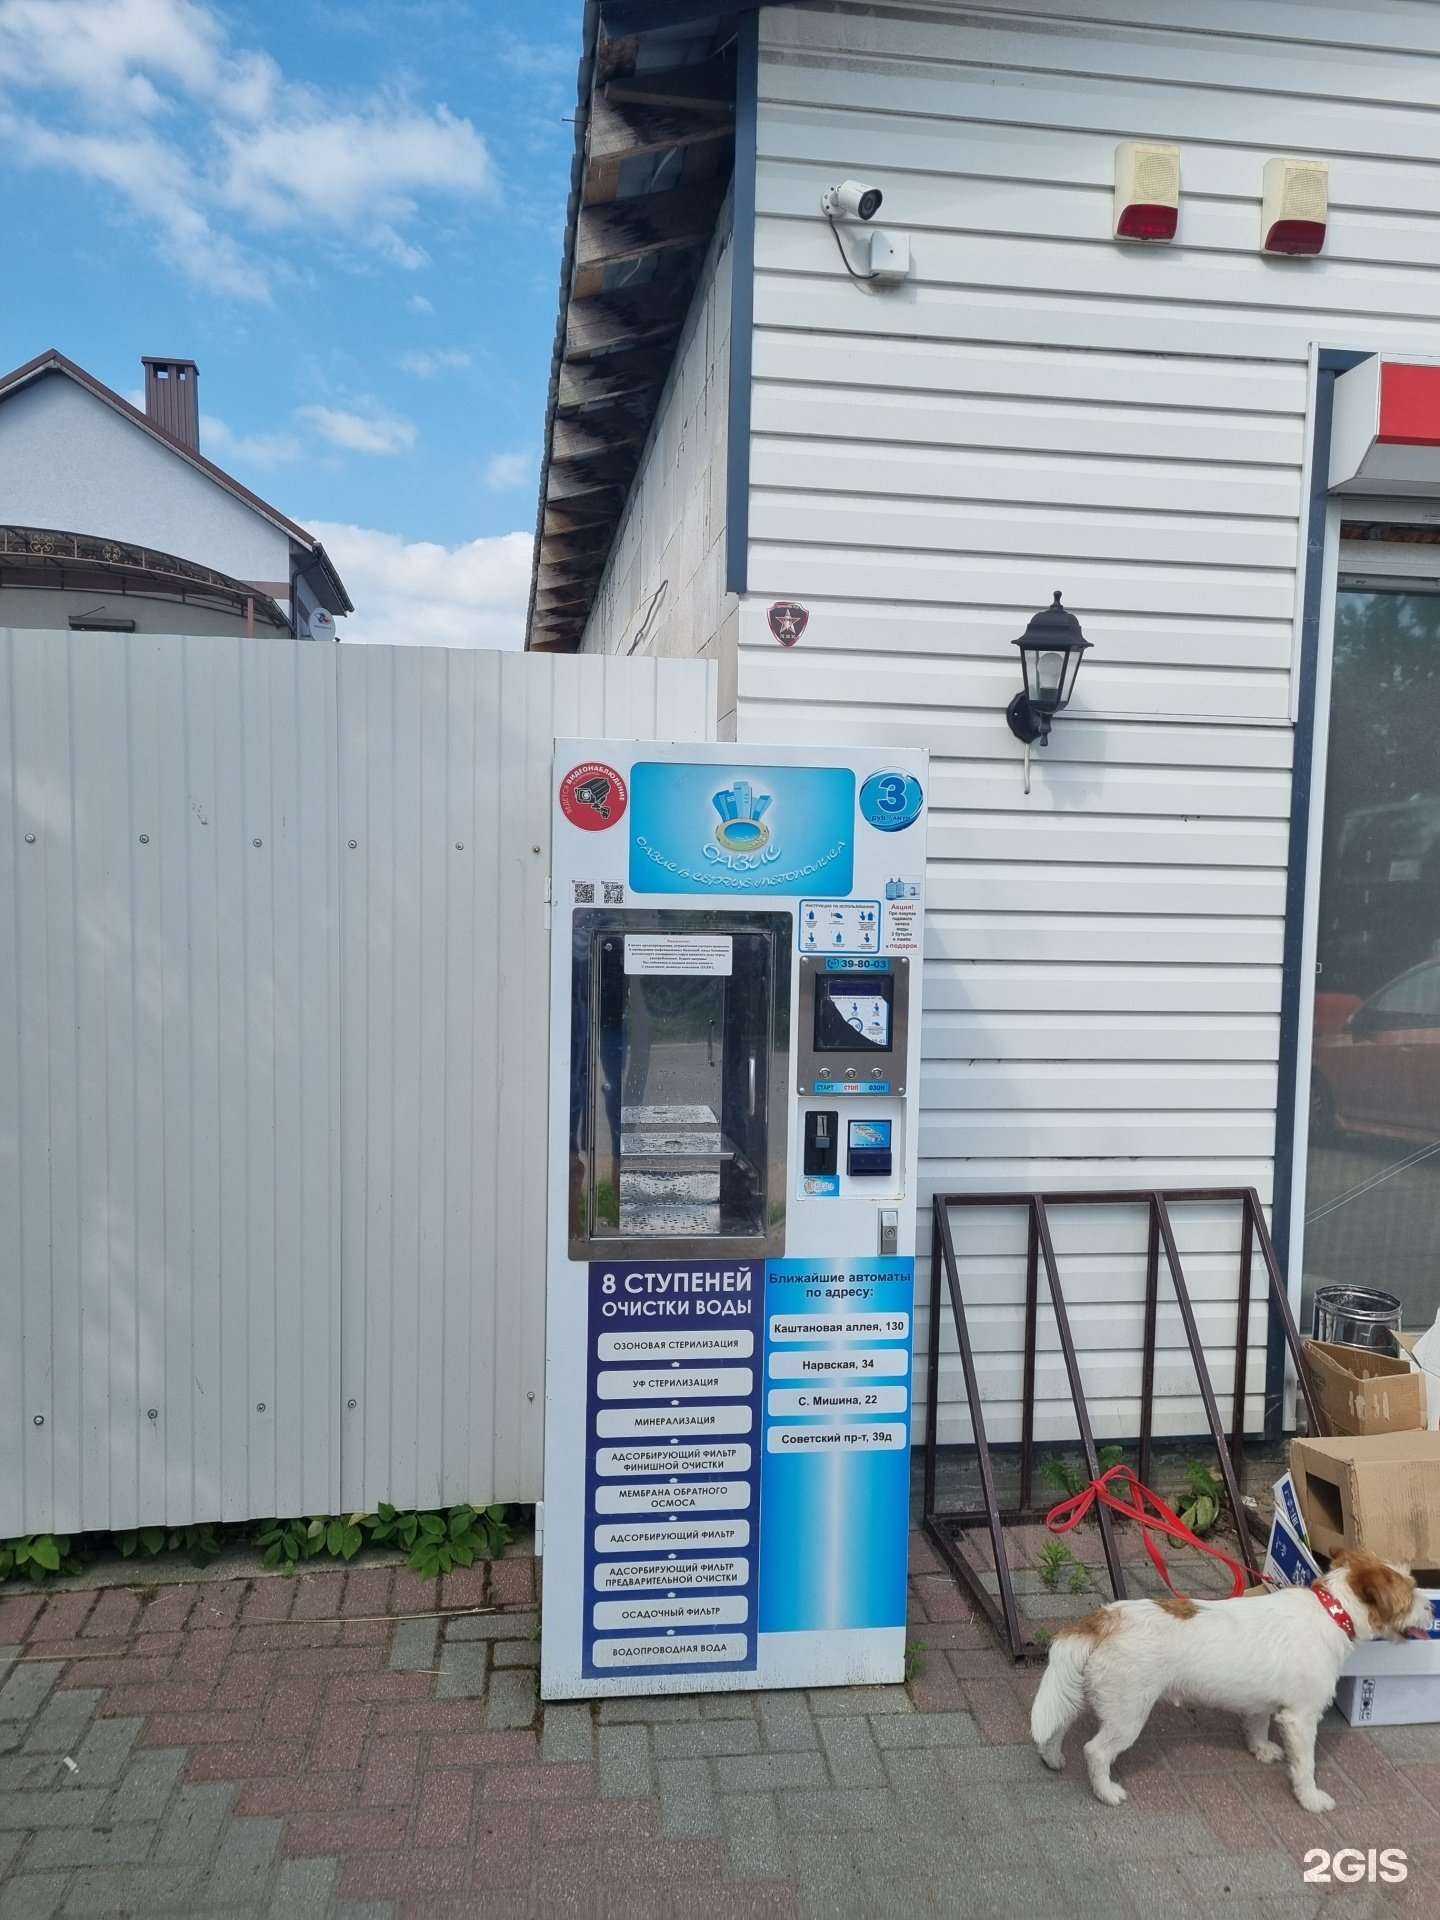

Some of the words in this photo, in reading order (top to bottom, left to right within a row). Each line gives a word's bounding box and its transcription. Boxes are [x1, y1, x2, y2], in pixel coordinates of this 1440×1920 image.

[566, 765, 625, 801] ВИДЕОНАБЛЮДЕНИЕ
[878, 775, 907, 814] 3
[702, 842, 782, 871] ОАЗИС
[840, 959, 887, 969] 39-80-03
[816, 1084, 834, 1092] СТАРТ
[843, 1084, 859, 1092] СТОП
[602, 1273, 617, 1294] 8
[624, 1266, 752, 1294] СТУПЕНЕЙ
[769, 1272, 845, 1284] Ближайшие
[848, 1272, 911, 1282] автоматы
[806, 1288, 821, 1297] по
[825, 1287, 874, 1299] адресу:
[602, 1300, 690, 1317] ОЧИСТКИ
[696, 1299, 752, 1316] ВОДЫ
[774, 1323, 843, 1333] Каштановая
[846, 1324, 882, 1332] аллея,
[885, 1321, 904, 1331] 130
[613, 1341, 666, 1351] ОЗОНОВАЯ
[668, 1340, 739, 1350] СТЕРИЛИЗАЦИЯ
[802, 1360, 858, 1372] Нарвская,
[861, 1359, 874, 1369] 34
[632, 1379, 646, 1388] УФ
[648, 1378, 719, 1388] СТЕРИЛИЗАЦИЯ
[798, 1396, 810, 1406] С.
[813, 1395, 862, 1406] Мишина,
[865, 1394, 878, 1404] 22
[634, 1416, 716, 1426] МИНЕРАЛИЗАЦИЯ
[781, 1432, 841, 1444] Советский
[844, 1434, 869, 1443] пр-т,
[872, 1432, 892, 1442] 39д
[611, 1449, 701, 1461] АДСОРБИРУЮЩИЙ
[702, 1449, 737, 1458] ФИЛЬТР
[623, 1460, 679, 1472] ФИНИШНОЙ
[681, 1461, 724, 1470] ОЧИСТКИ
[618, 1488, 671, 1498] МЕМБРАНА
[673, 1486, 728, 1496] ОБРАТНОГО
[651, 1499, 696, 1508] ОСМОСА
[610, 1530, 699, 1543] АДСОРБИРУЮЩИЙ
[701, 1530, 735, 1539] ФИЛЬТР
[609, 1563, 698, 1576] АДСОРБИРУЮЩИЙ
[700, 1563, 734, 1572] ФИЛЬТР
[605, 1574, 693, 1587] ПРЕДВАРИТЕЛЬНОЙ
[695, 1574, 738, 1584] ОЧИСТКИ
[621, 1607, 684, 1619] ОСАДОЧНЫЙ
[686, 1607, 721, 1616] ФИЛЬТР
[612, 1645, 698, 1657] ВОДОПРОВОДНАЯ
[700, 1643, 728, 1653] ВОДА
